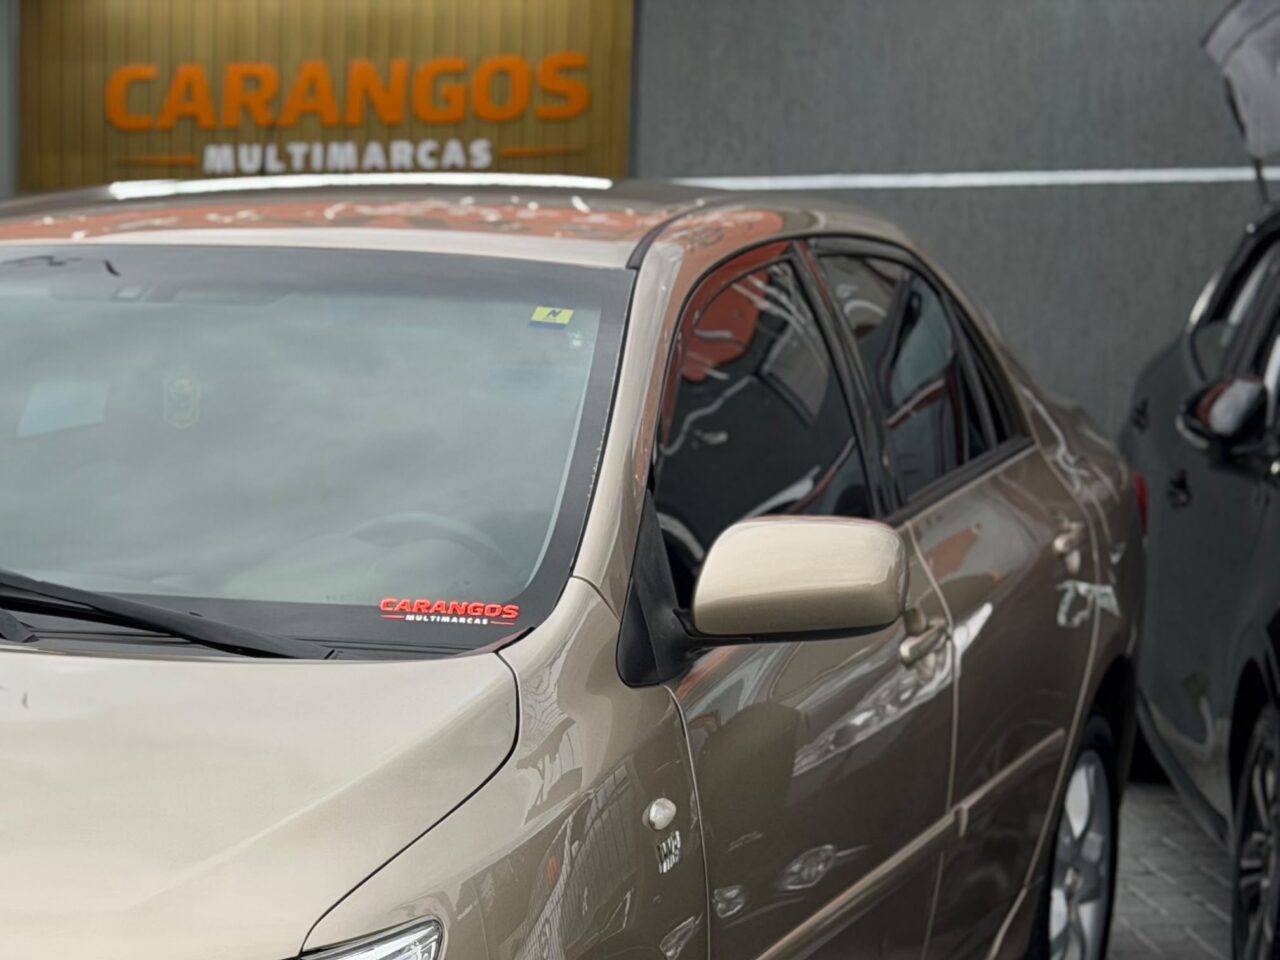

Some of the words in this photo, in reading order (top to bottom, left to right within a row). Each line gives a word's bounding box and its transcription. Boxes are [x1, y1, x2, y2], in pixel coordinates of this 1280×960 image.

[105, 53, 591, 131] CARANGOS
[204, 140, 492, 173] MULTIMARCAS
[380, 598, 519, 619] CARANGOS
[405, 614, 488, 625] MULTIMARCAS
